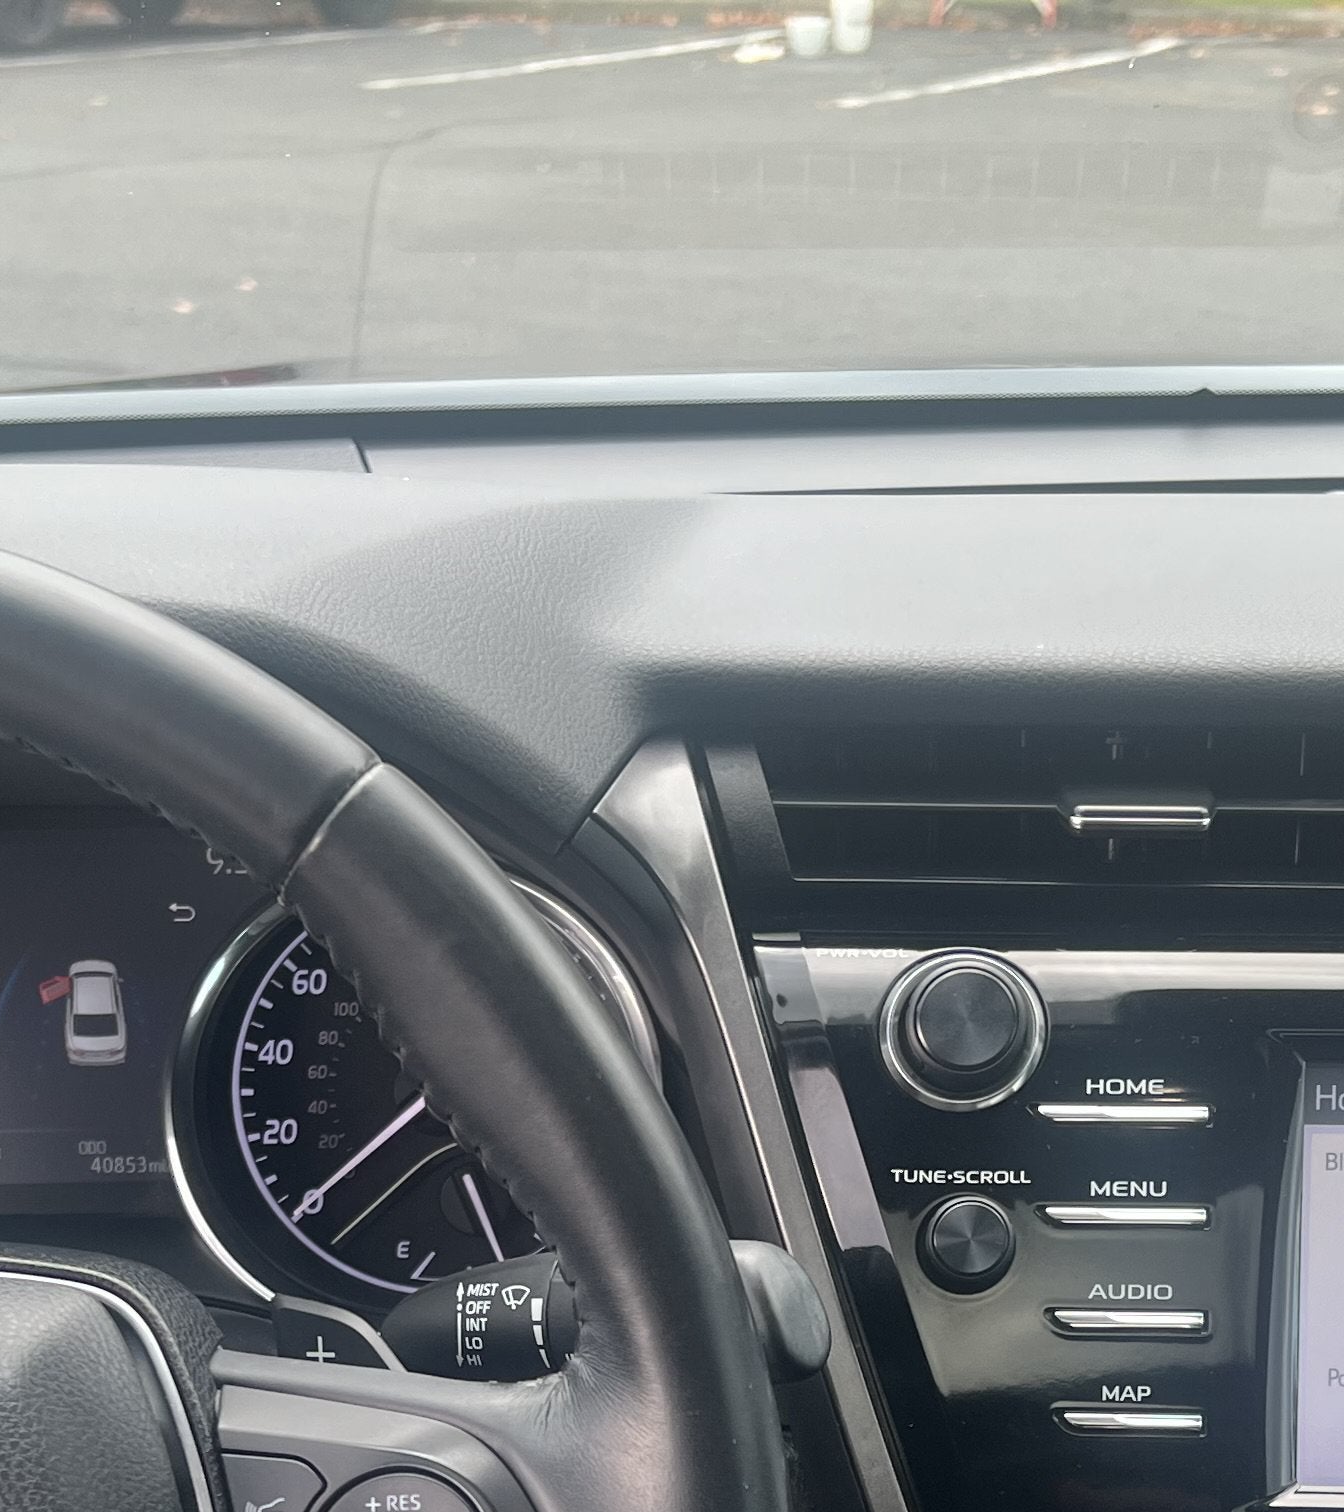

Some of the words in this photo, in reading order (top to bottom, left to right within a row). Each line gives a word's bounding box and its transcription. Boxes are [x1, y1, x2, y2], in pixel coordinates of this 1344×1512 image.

[292, 969, 327, 995] 60
[318, 1031, 339, 1045] 80
[258, 1039, 294, 1065] 40
[308, 1065, 328, 1079] 60
[1085, 1078, 1164, 1096] HOME
[308, 1100, 328, 1114] 40
[263, 1118, 298, 1145] 20
[78, 1140, 107, 1155] ODO
[318, 1135, 339, 1149] 20
[1089, 1180, 1168, 1198] MENU
[396, 1241, 411, 1259] E
[467, 1283, 499, 1297] MIST
[1088, 1283, 1173, 1301] AUDIO
[465, 1301, 491, 1315] OFF
[466, 1318, 488, 1331] INT
[465, 1336, 483, 1350] LO
[466, 1354, 483, 1366] HI
[1101, 1385, 1152, 1403] MAP
[386, 1494, 422, 1512] RES
